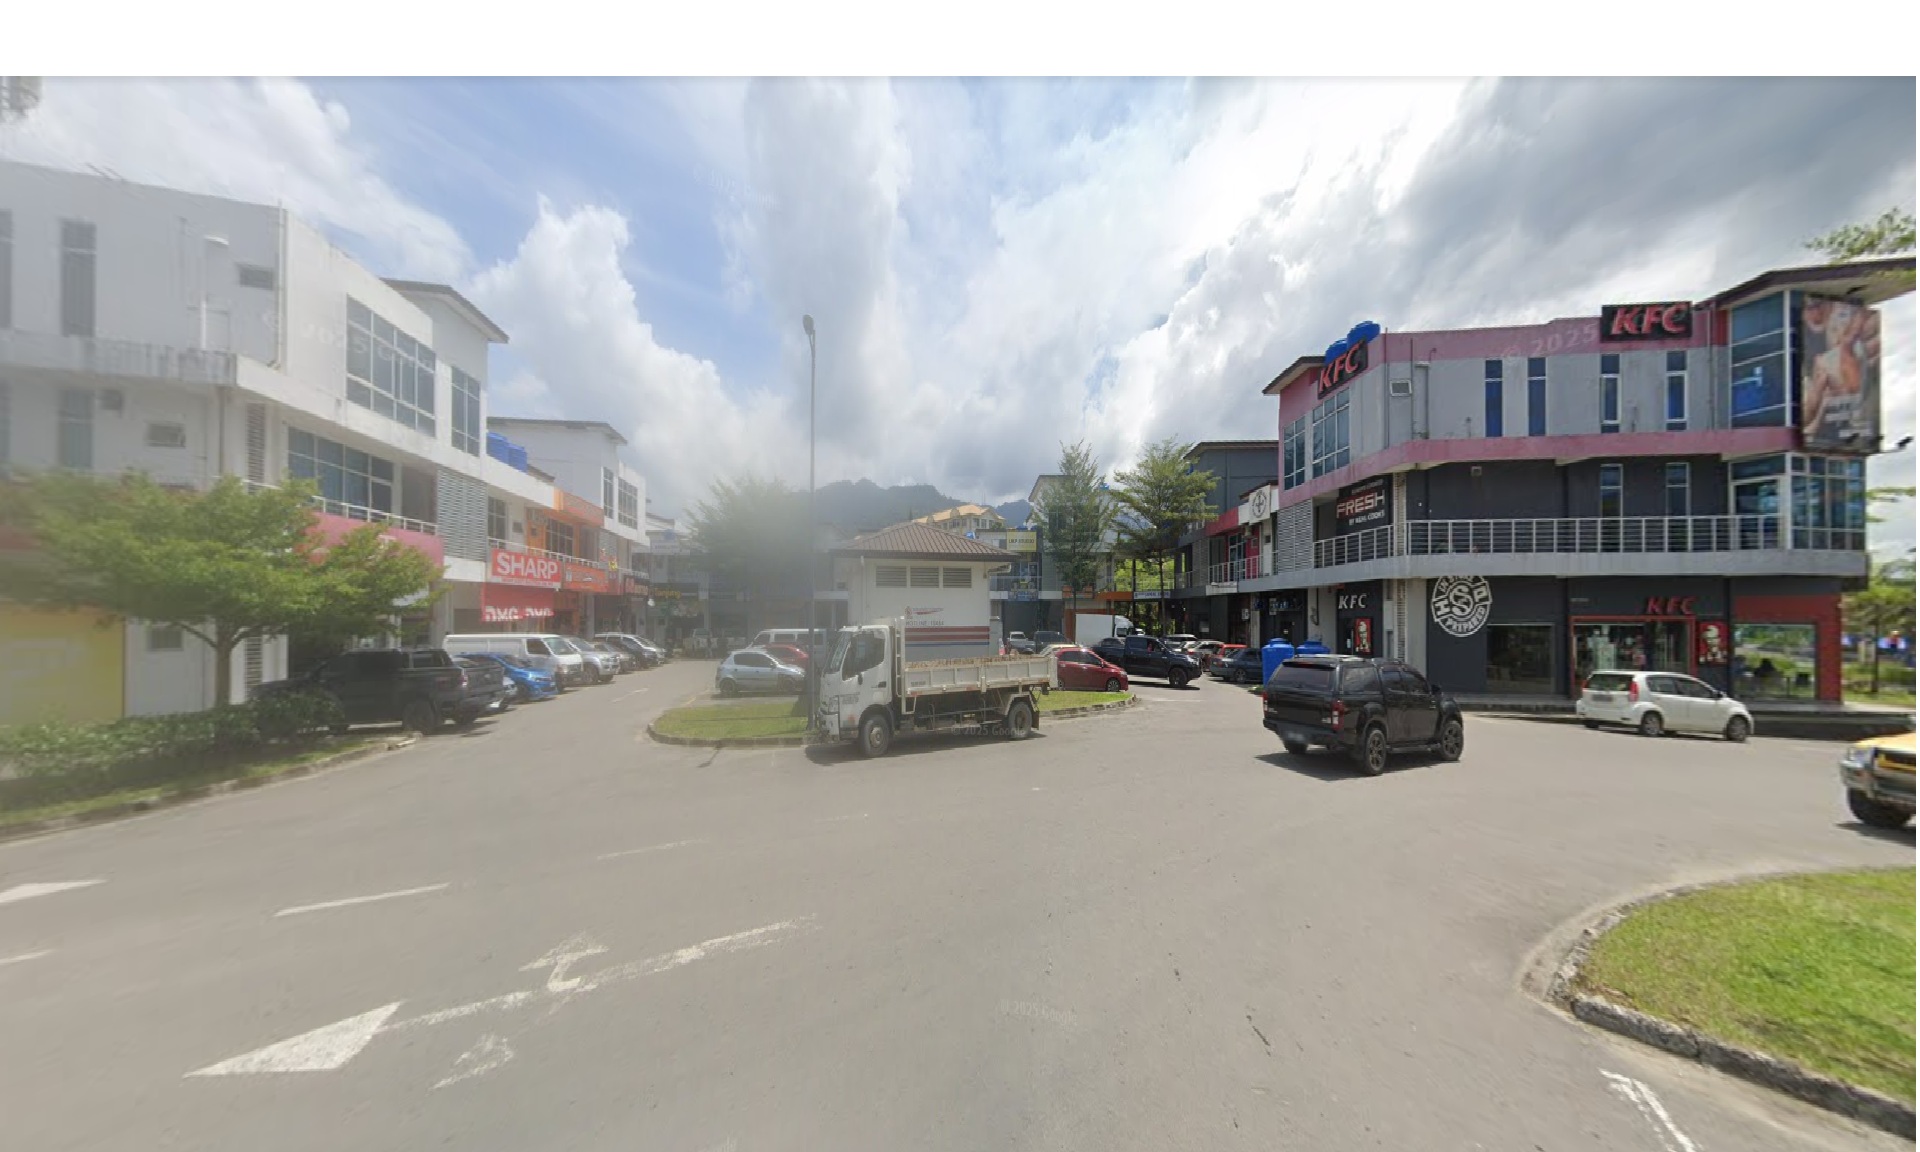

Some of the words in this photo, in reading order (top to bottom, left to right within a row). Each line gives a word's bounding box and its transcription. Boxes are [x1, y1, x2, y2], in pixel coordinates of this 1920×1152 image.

[1611, 303, 1688, 335] KFC
[1319, 342, 1361, 392] KFC
[1336, 489, 1385, 519] FRESH
[496, 552, 559, 580] SHARP
[1338, 593, 1367, 609] KFC
[1646, 596, 1697, 615] KFC
